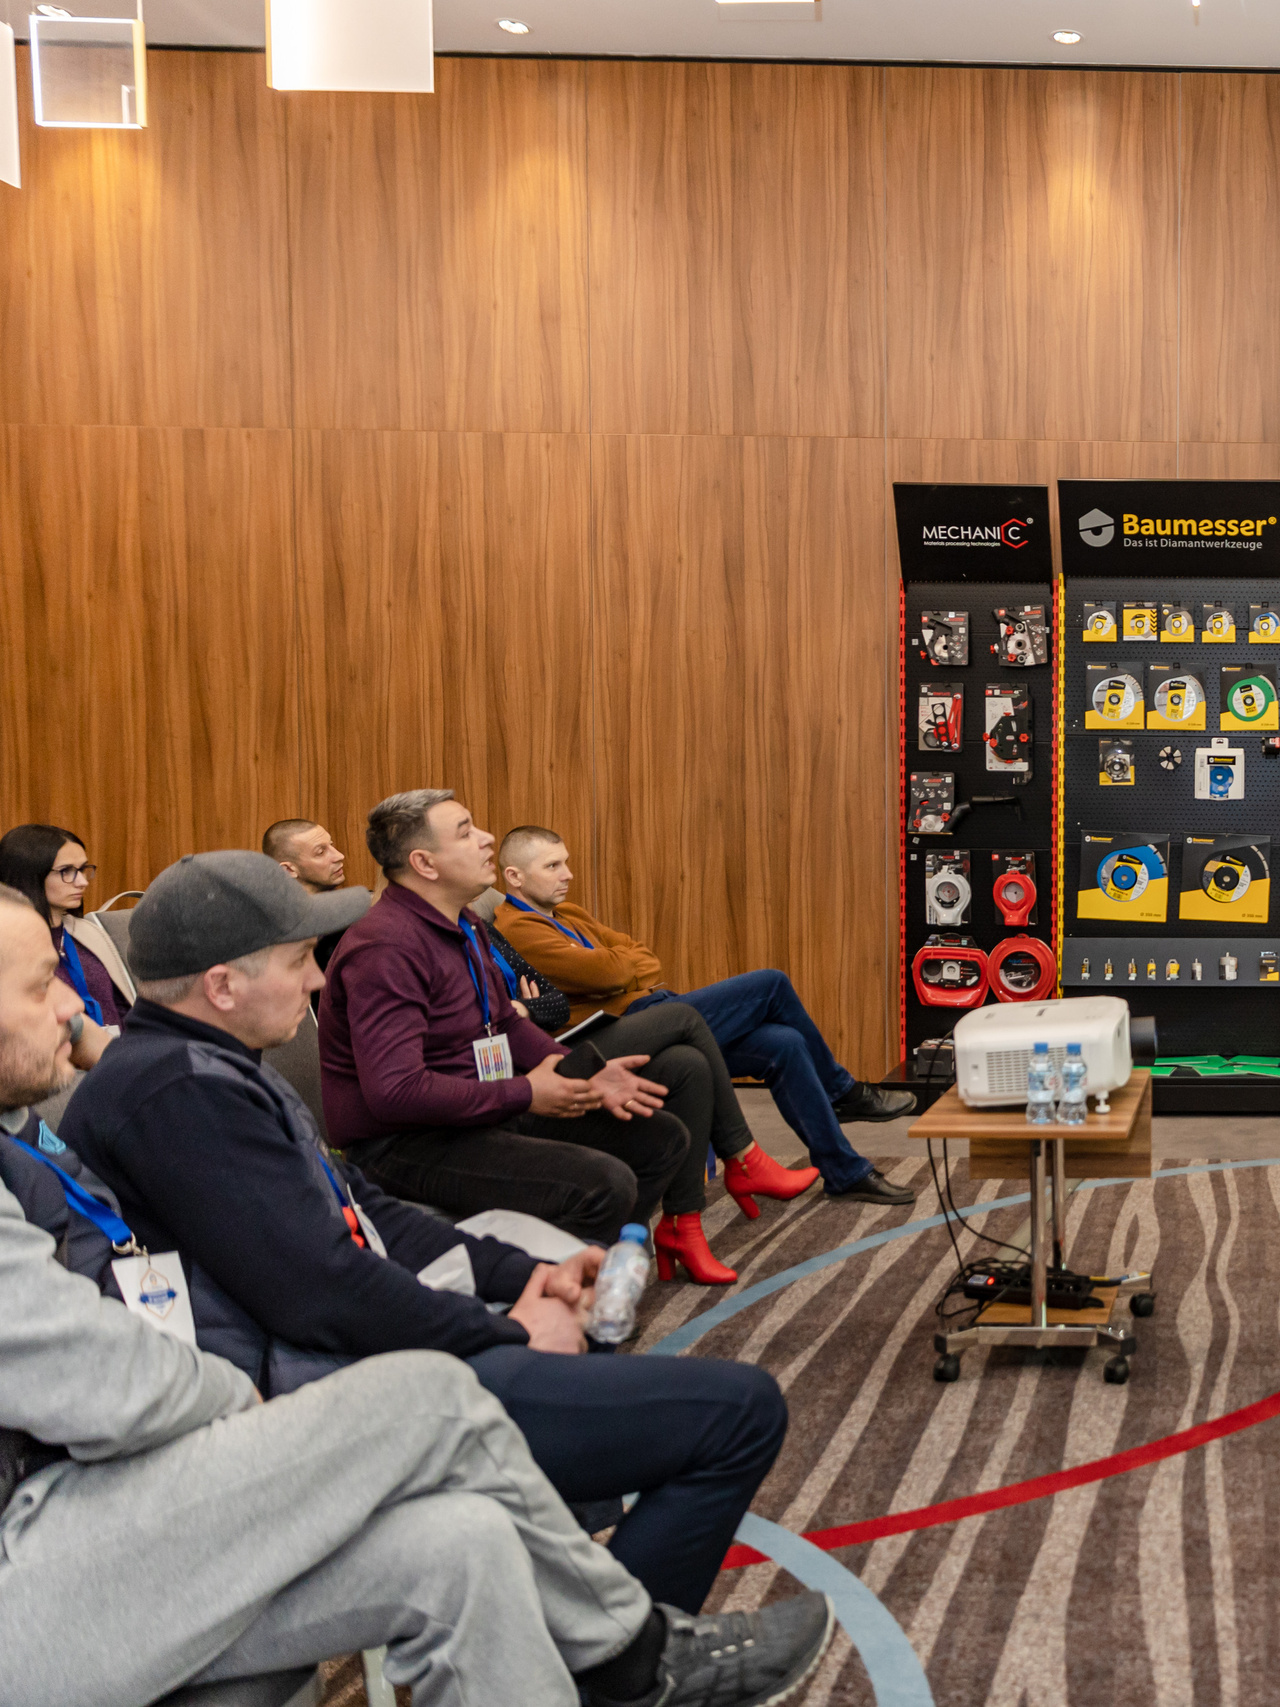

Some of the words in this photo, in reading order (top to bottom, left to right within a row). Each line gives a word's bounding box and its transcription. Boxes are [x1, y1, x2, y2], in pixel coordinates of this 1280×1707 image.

[1122, 513, 1267, 536] Baumesser
[1123, 538, 1143, 547] Das
[1145, 538, 1158, 548] ist
[1160, 538, 1263, 551] Diamantwerkzeuge
